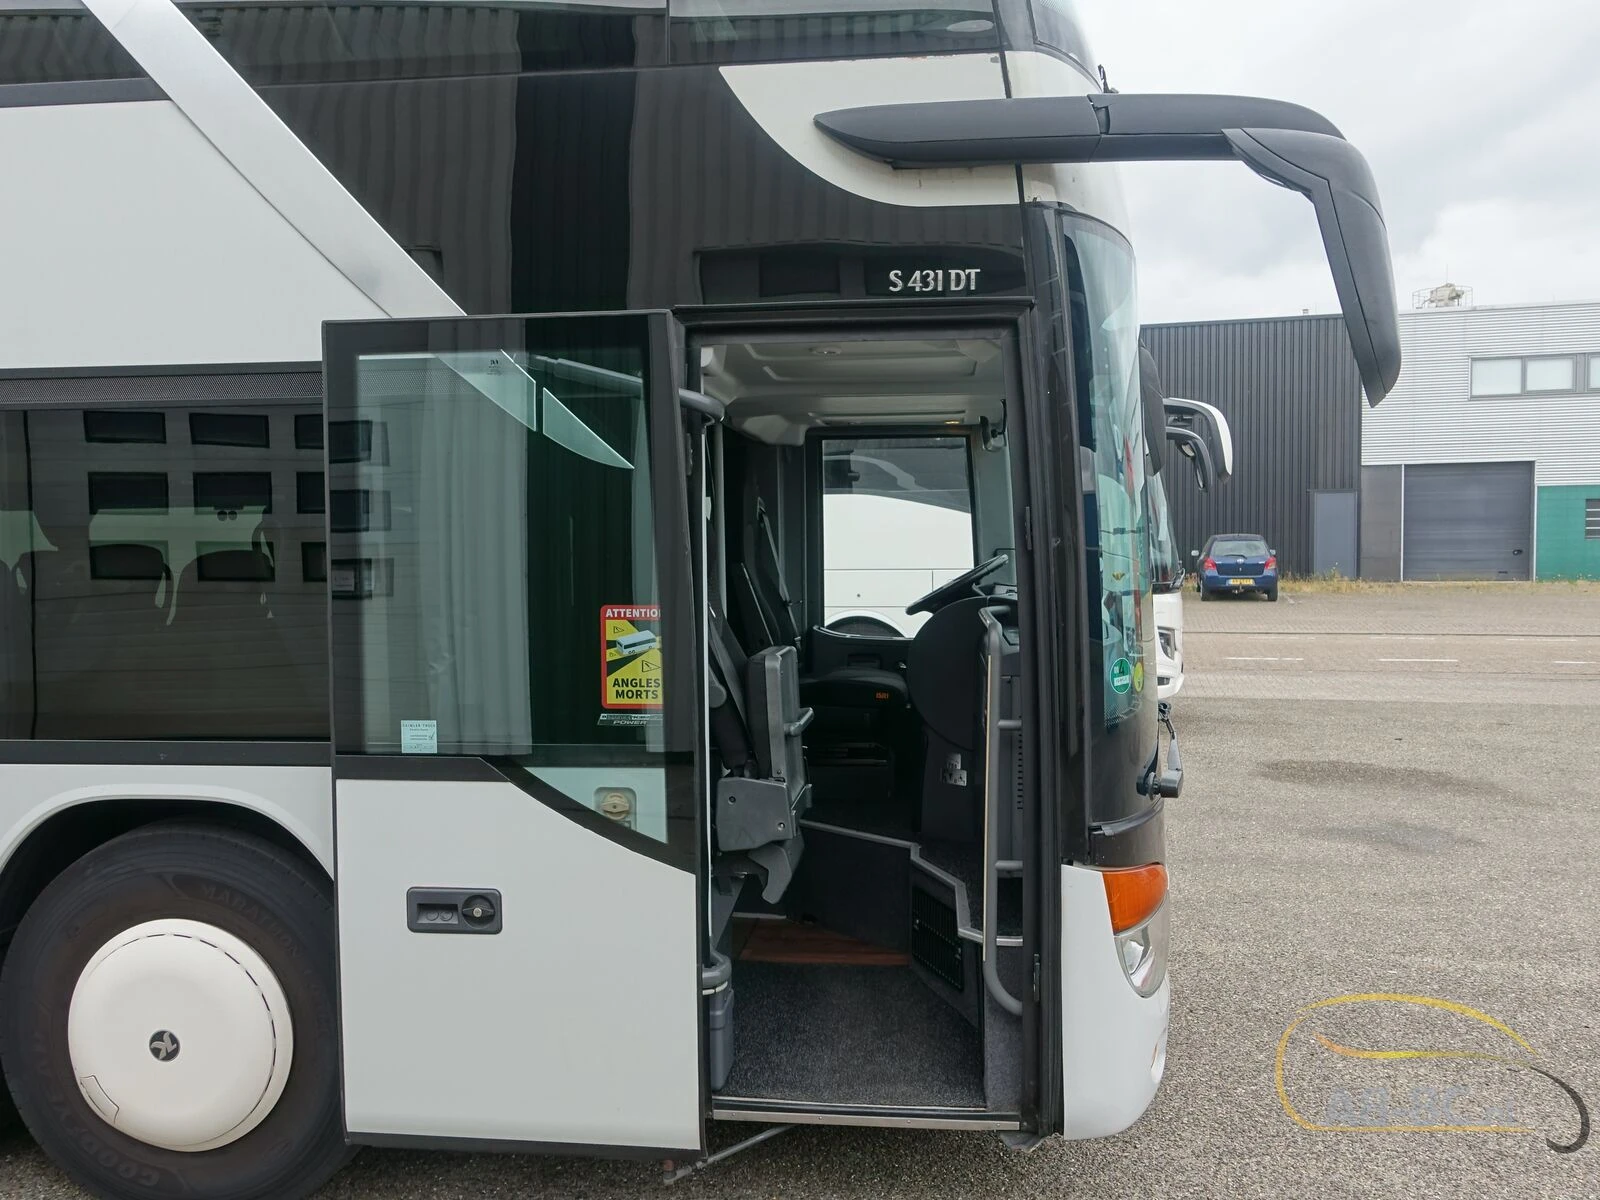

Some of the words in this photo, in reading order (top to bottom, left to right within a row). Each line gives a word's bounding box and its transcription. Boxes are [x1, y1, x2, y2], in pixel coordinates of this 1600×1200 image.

[888, 269, 903, 292] S
[907, 269, 943, 292] 431
[948, 268, 981, 291] DT
[612, 677, 661, 688] ANGLES
[615, 689, 659, 700] MORTS
